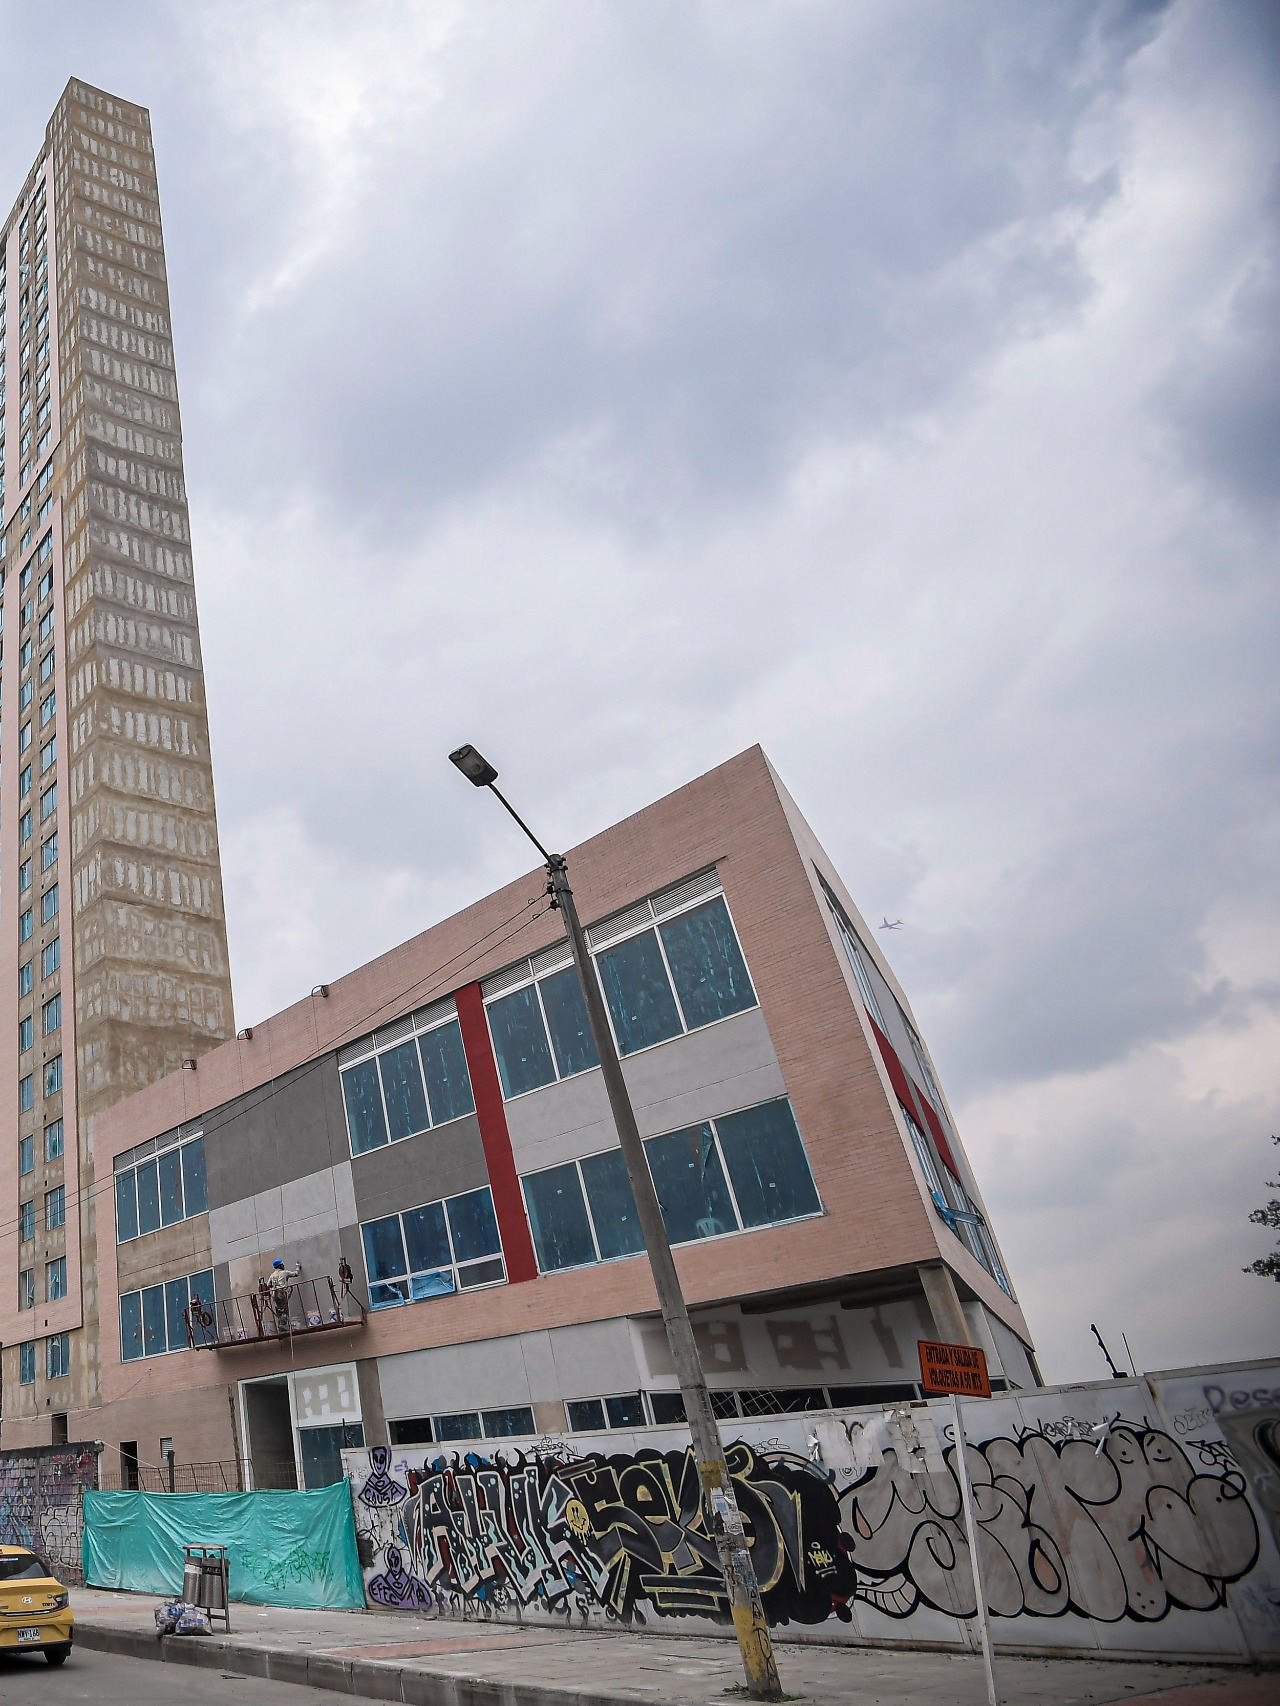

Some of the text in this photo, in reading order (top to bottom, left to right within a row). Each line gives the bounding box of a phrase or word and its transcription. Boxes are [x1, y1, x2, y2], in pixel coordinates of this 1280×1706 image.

[925, 1345, 949, 1365] ENTRADA
[954, 1349, 974, 1368] SALIDA
[971, 1351, 980, 1369] DE
[928, 1368, 960, 1388] VOLQUETAS
[364, 1487, 403, 1506] CAUSA
